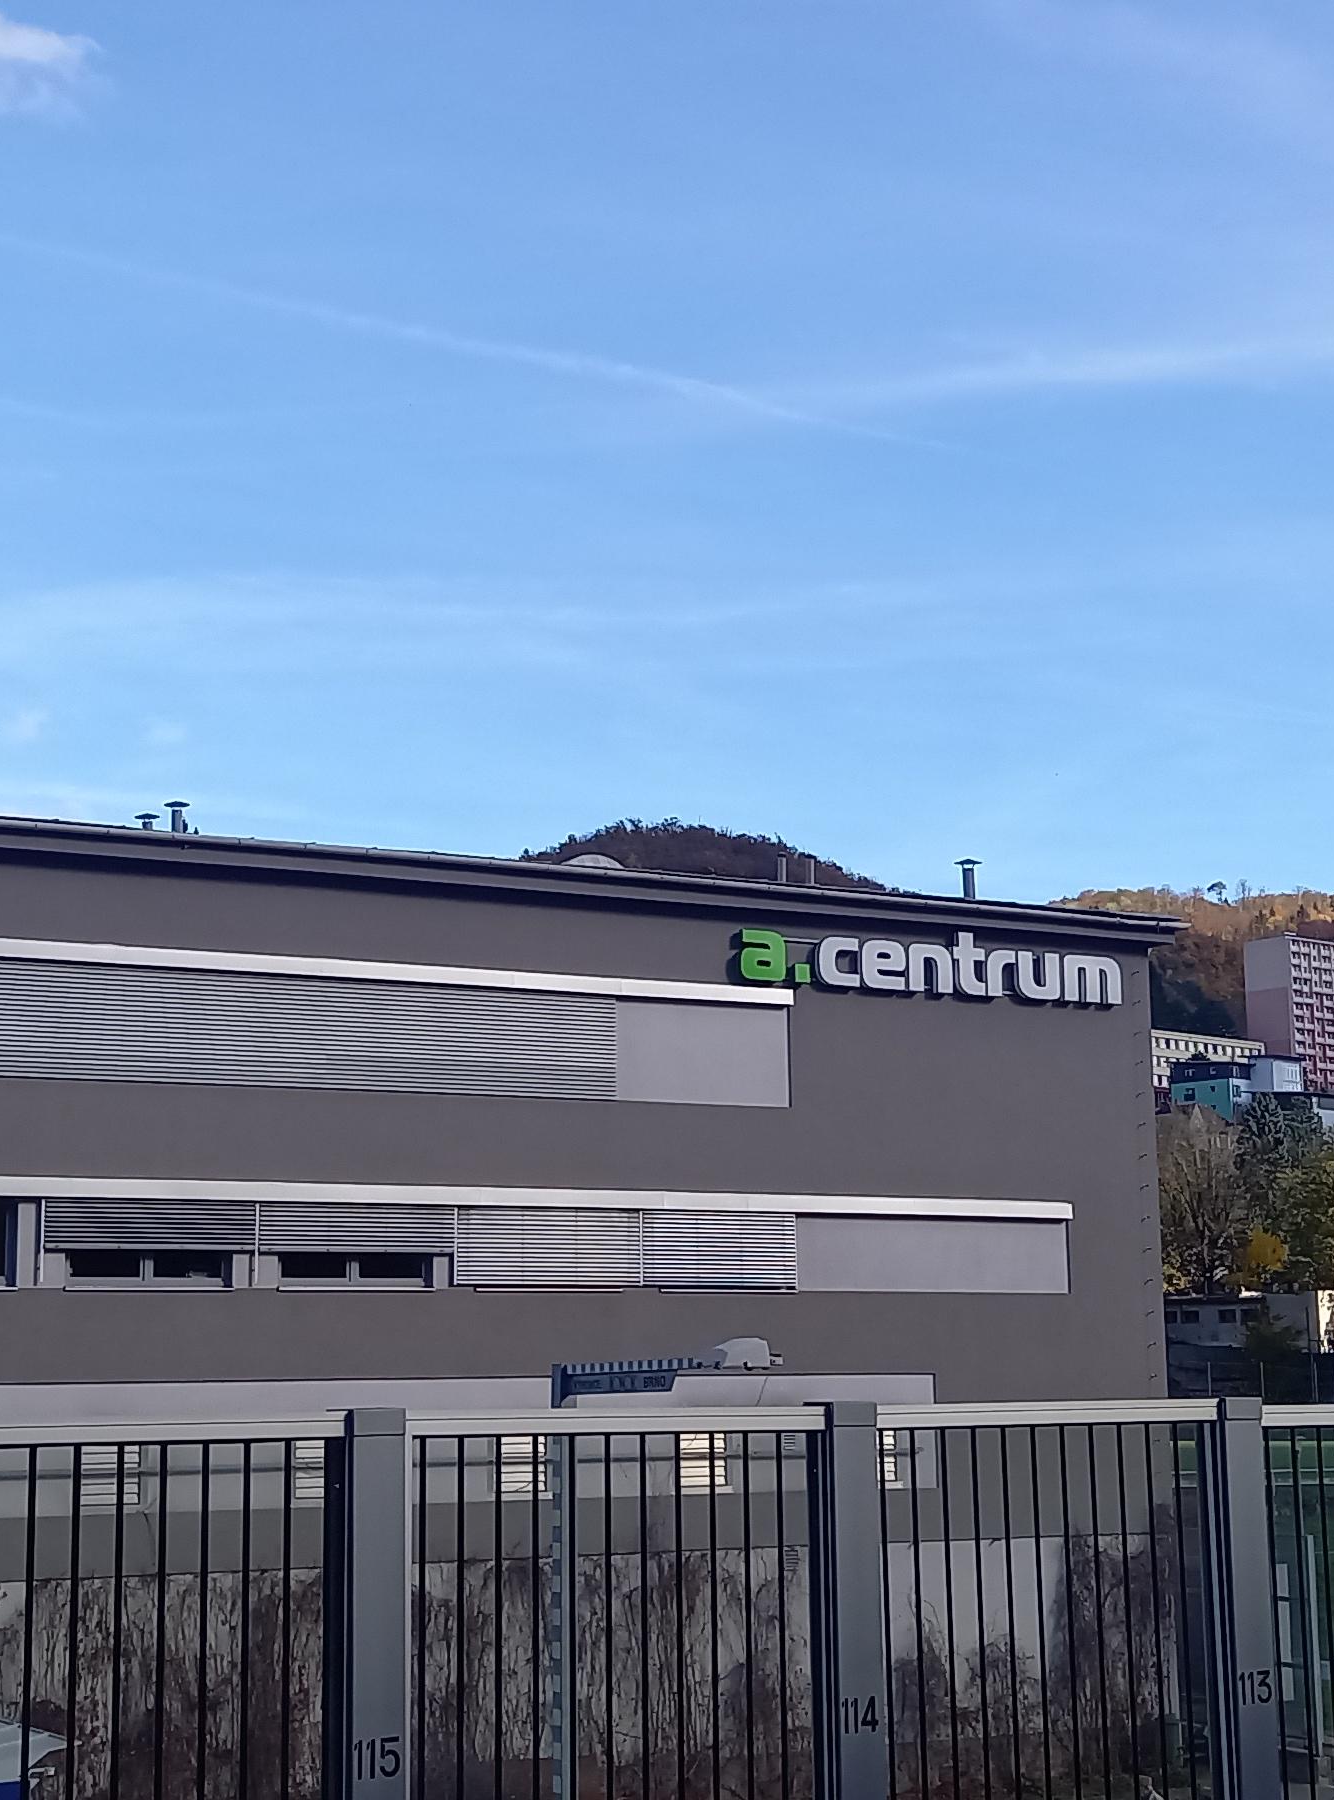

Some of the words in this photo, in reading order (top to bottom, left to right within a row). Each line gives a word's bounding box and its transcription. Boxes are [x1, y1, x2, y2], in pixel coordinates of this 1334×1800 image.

[739, 928, 1123, 1005] a.centrum
[1238, 1669, 1273, 1706] 113
[841, 1695, 879, 1735] 114
[353, 1735, 401, 1781] 115
